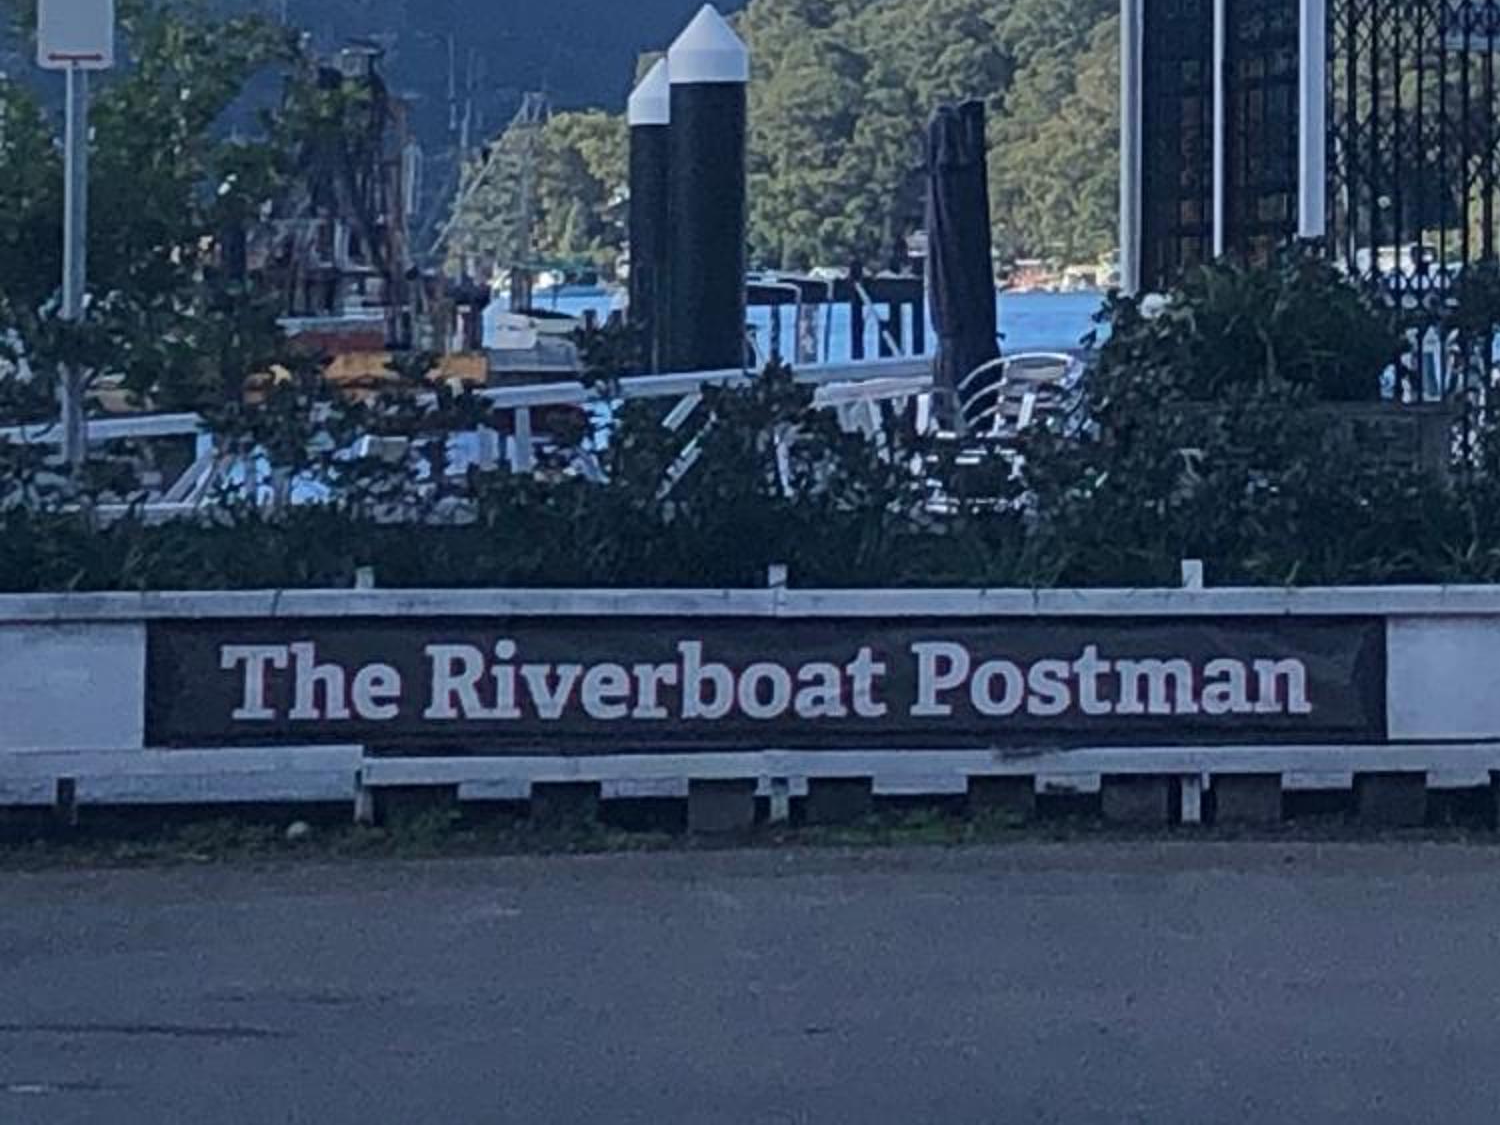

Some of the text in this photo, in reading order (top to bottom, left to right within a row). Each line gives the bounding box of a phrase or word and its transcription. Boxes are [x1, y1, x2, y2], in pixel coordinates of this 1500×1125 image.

[221, 639, 1313, 720] The Riverboat Postman
